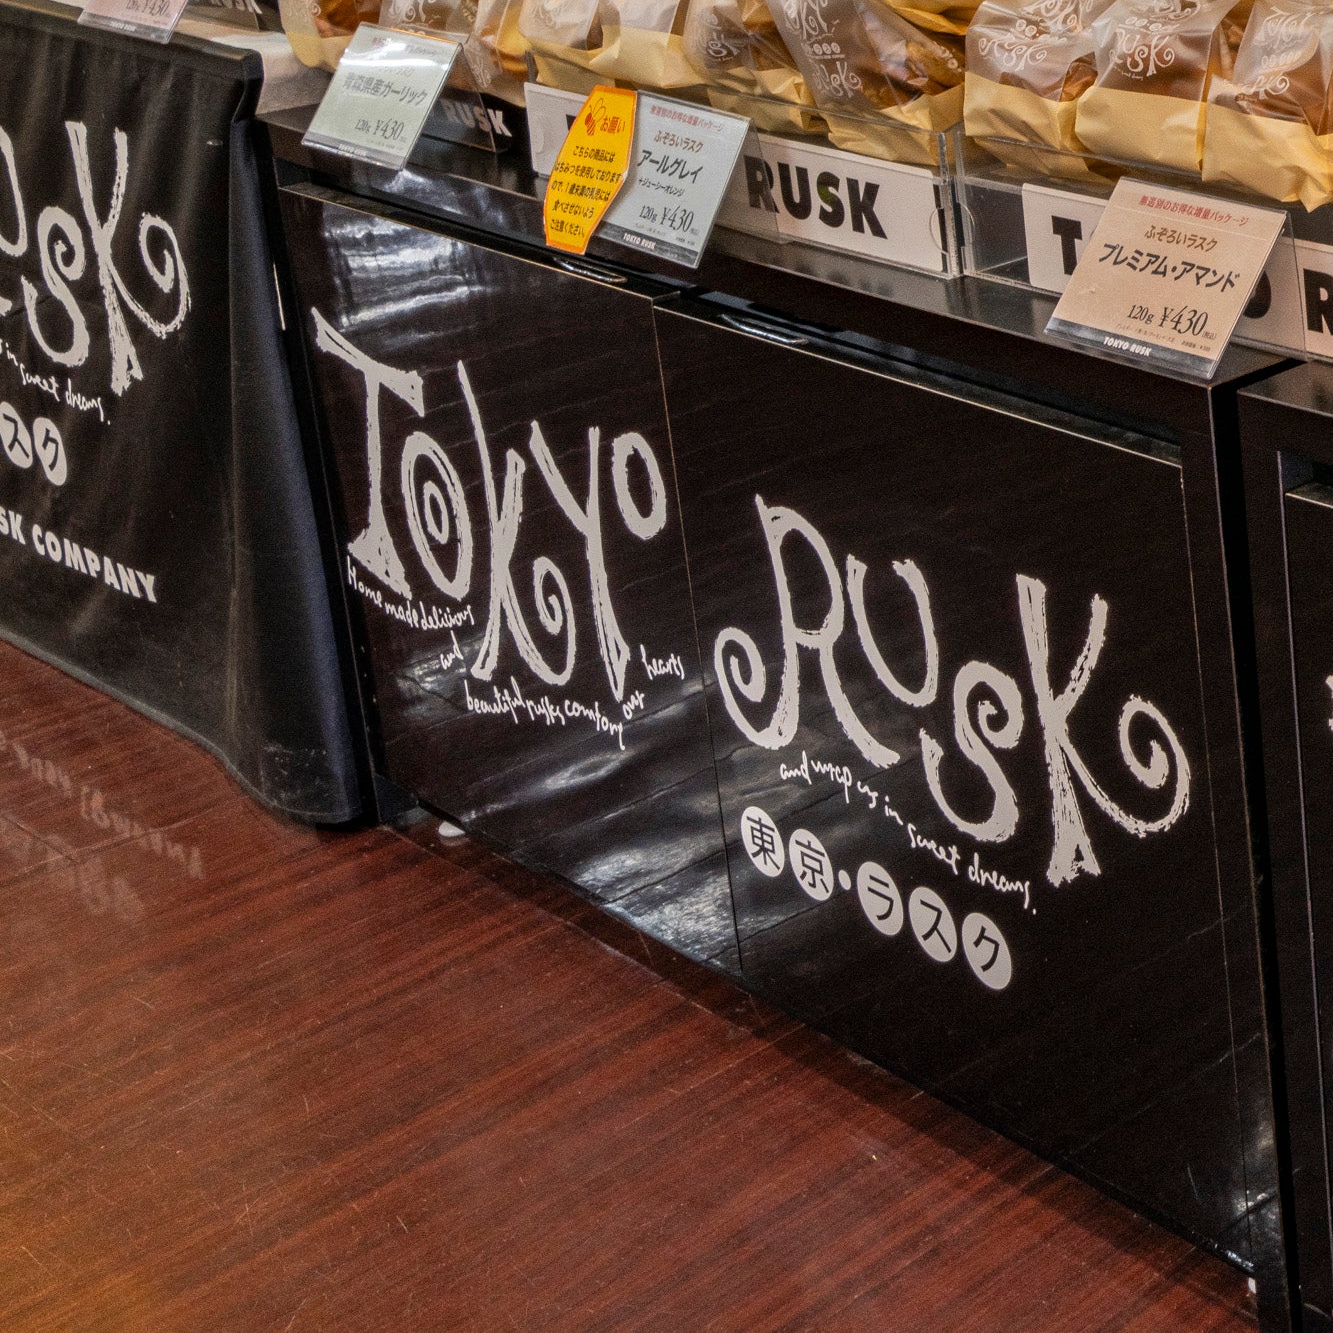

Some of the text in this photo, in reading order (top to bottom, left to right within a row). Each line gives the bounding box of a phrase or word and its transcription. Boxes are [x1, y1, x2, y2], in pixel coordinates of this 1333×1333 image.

[443, 98, 512, 137] RUSK
[600, 116, 625, 134] お願い
[637, 149, 704, 185] アールグレイ
[639, 205, 658, 223] 120g
[660, 205, 694, 233] ¥430
[743, 155, 888, 239] RUSK
[1145, 224, 1218, 252] ふぞろいラスク
[1098, 242, 1241, 293] プレミアム・アマンド
[1127, 304, 1155, 325] 120g
[1159, 305, 1208, 336] ¥430
[311, 307, 668, 705] TOKYO
[32, 525, 158, 604] COMPANY
[347, 556, 383, 608] Home
[714, 495, 1191, 887] RUSK
[780, 750, 812, 786] and
[740, 805, 1012, 990] 東京・ラスク
